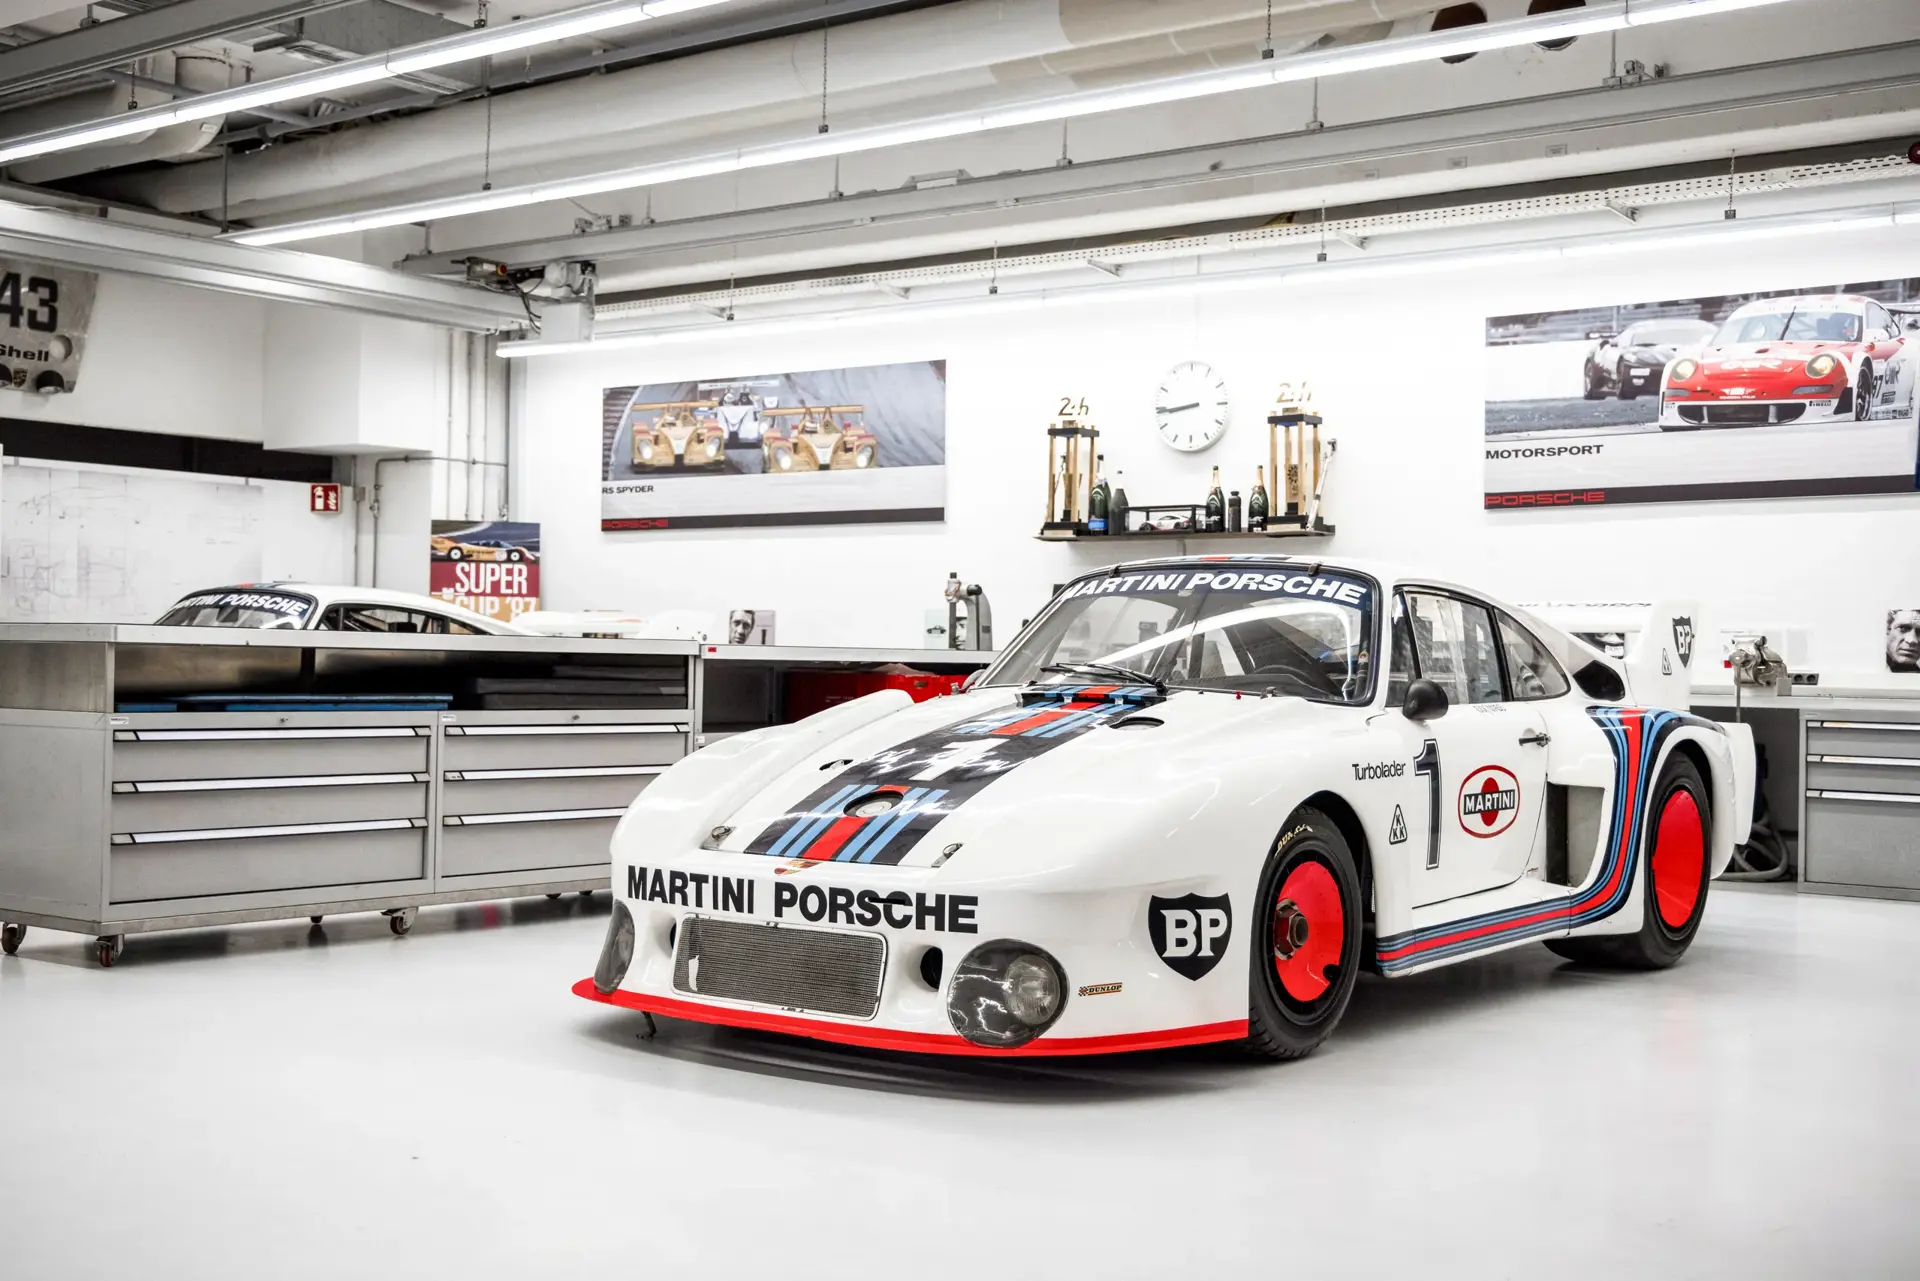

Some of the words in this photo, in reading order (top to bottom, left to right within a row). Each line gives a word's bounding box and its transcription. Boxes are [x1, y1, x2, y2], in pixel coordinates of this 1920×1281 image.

[1485, 444, 1604, 460] MOTORSPORT
[602, 486, 614, 495] RS
[616, 485, 654, 494] SPYDER
[1485, 491, 1605, 506] PORSCHE
[455, 562, 527, 595] SUPER
[1185, 573, 1368, 605] PORSCHE
[219, 593, 308, 616] PORSCHE
[1675, 615, 1693, 655] BP
[1352, 760, 1406, 781] Turbolader
[1413, 738, 1442, 871] 1
[1465, 791, 1515, 814] MARTINI
[628, 865, 755, 915] MARTINI
[774, 882, 979, 934] PORSCHE
[1159, 908, 1229, 958] BP
[1089, 984, 1122, 993] DUNLOP
